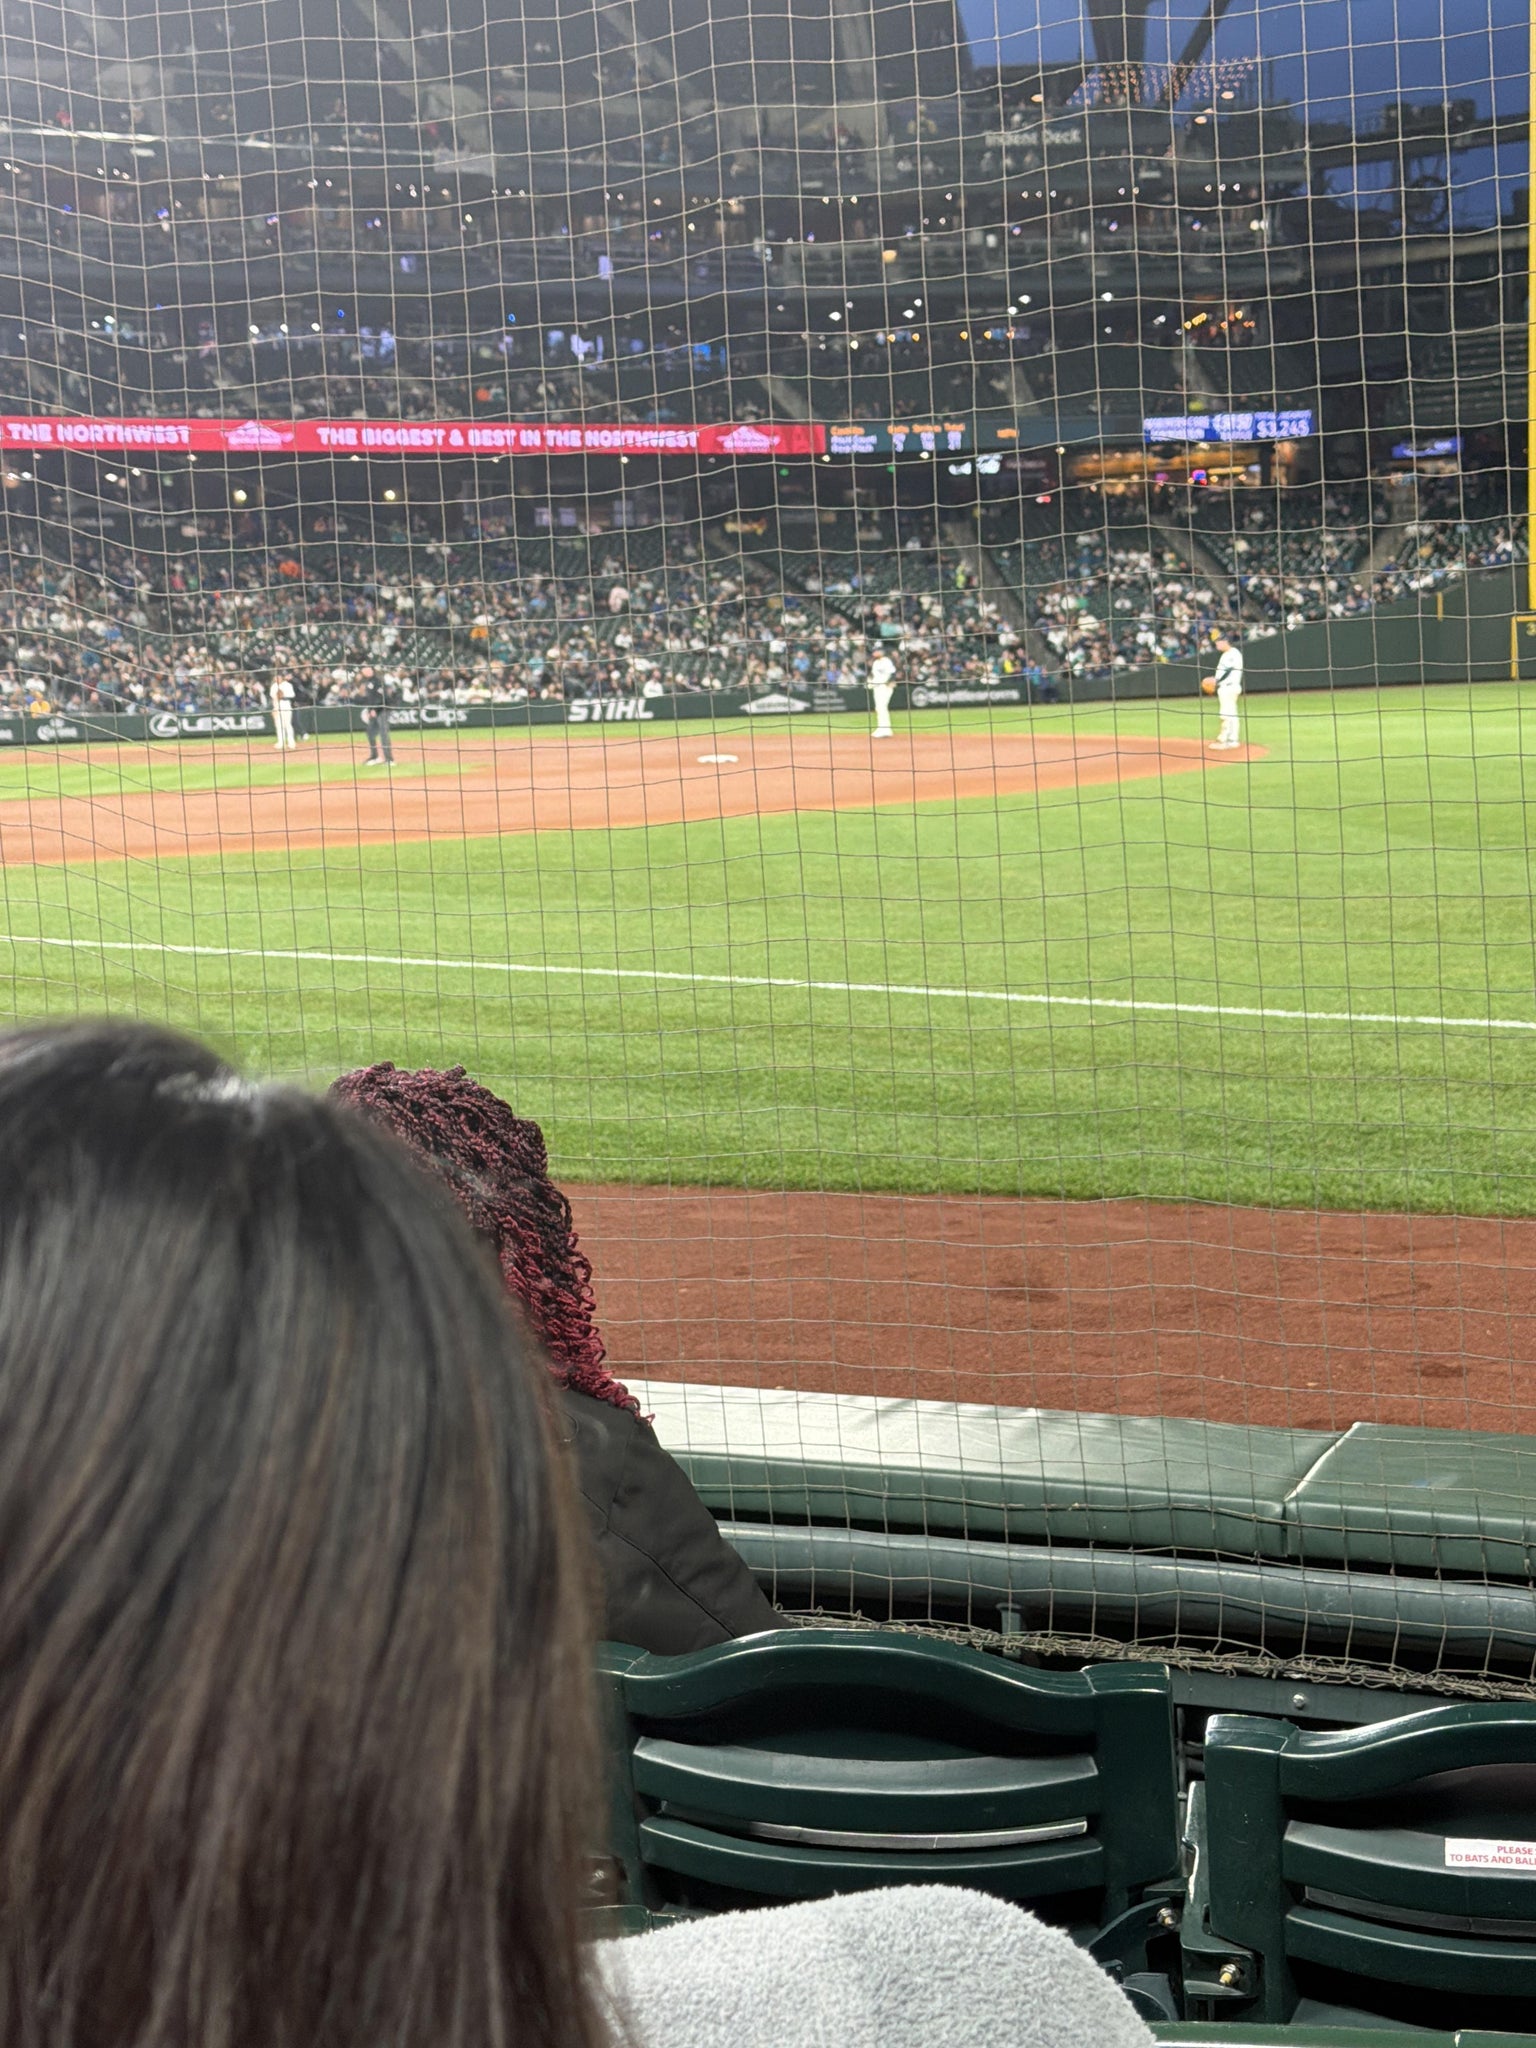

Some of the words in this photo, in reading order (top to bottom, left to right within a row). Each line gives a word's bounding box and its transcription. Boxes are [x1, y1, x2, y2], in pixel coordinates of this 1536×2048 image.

[7, 425, 52, 441] THE
[57, 425, 190, 443] NORTHWEST
[317, 427, 357, 445] THE
[362, 427, 443, 446] BIGGEST
[451, 428, 464, 446] &
[469, 427, 515, 447] BEST
[520, 429, 540, 446] IN
[545, 429, 581, 447] THE
[585, 430, 699, 448] NORTHWEST
[420, 704, 468, 726] Clips
[568, 698, 654, 722] STIHL
[182, 714, 265, 733] LEXUS
[1449, 1853, 1463, 1862] TO
[1464, 1854, 1489, 1863] BATS
[1491, 1855, 1513, 1864] AND
[1497, 1845, 1533, 1855] PLEASE
